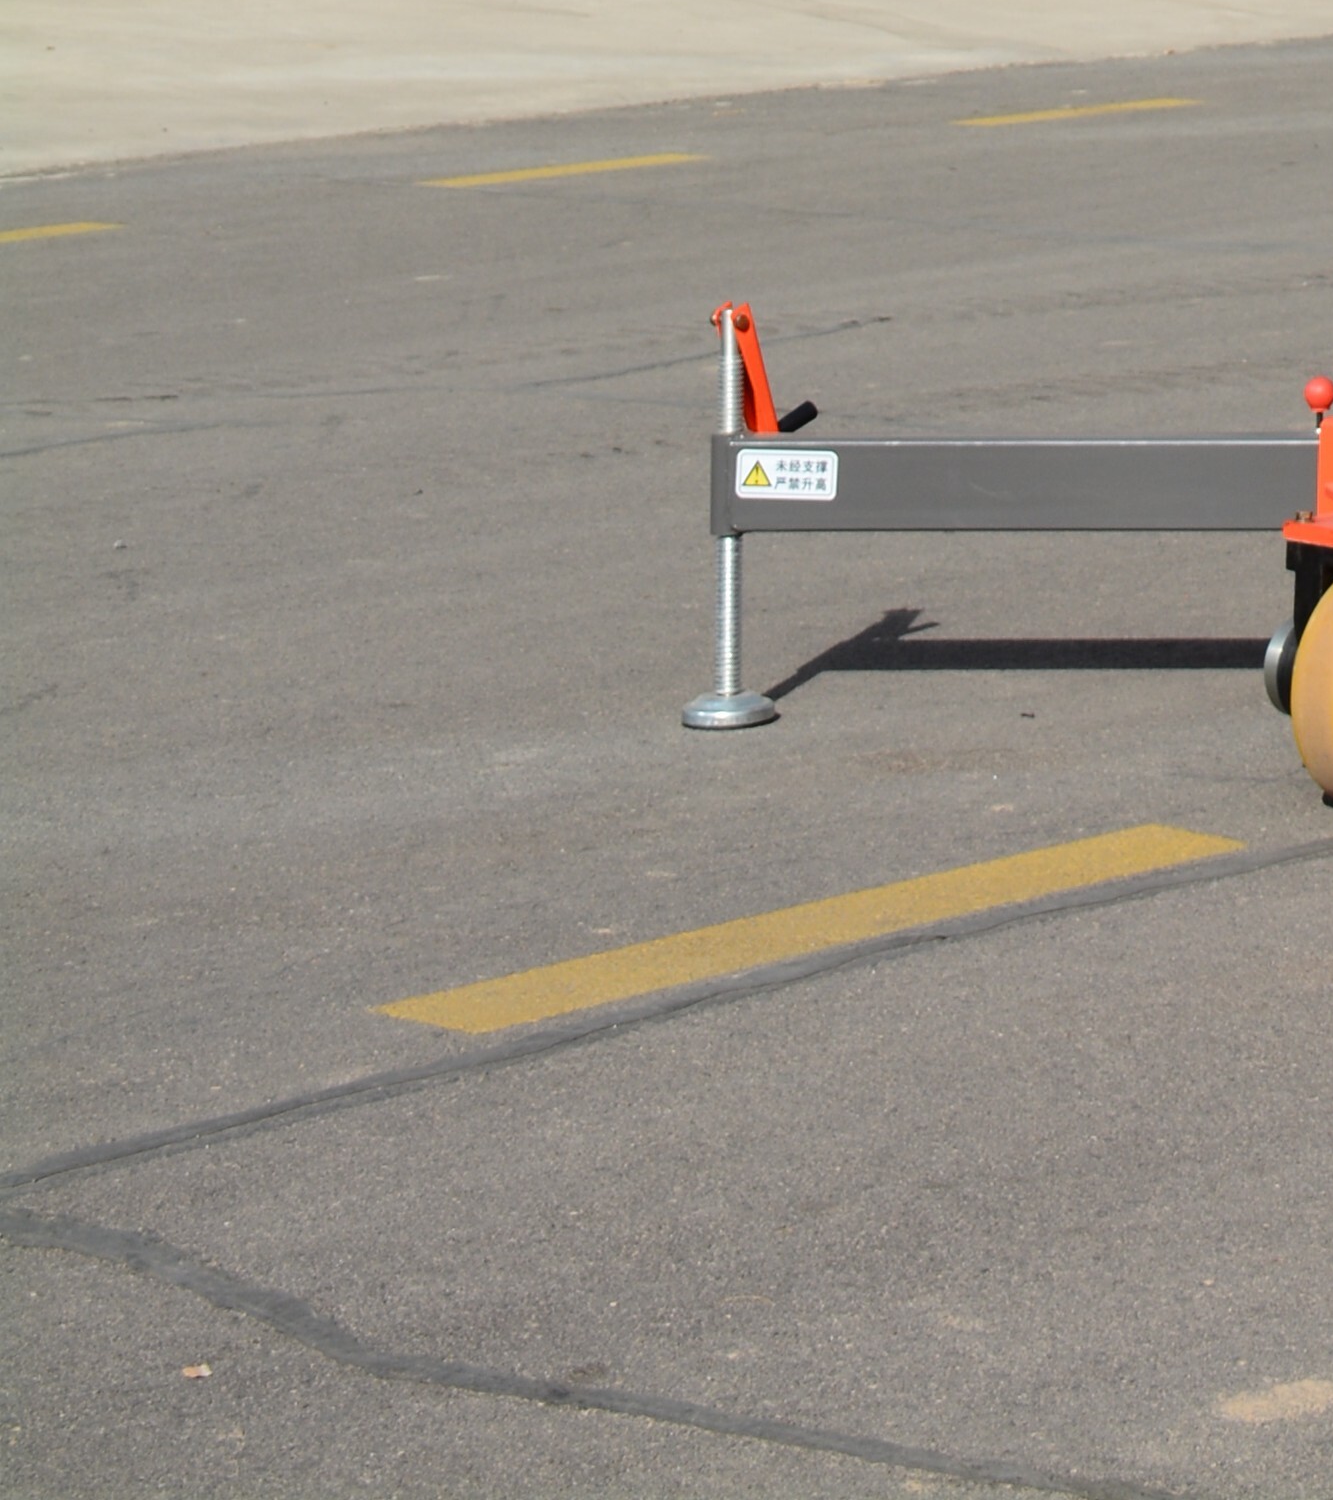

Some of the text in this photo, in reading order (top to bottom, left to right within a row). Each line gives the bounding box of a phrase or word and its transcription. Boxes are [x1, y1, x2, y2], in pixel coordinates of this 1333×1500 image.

[775, 460, 828, 473] 未经支撑
[774, 477, 828, 491] 严禁升高
